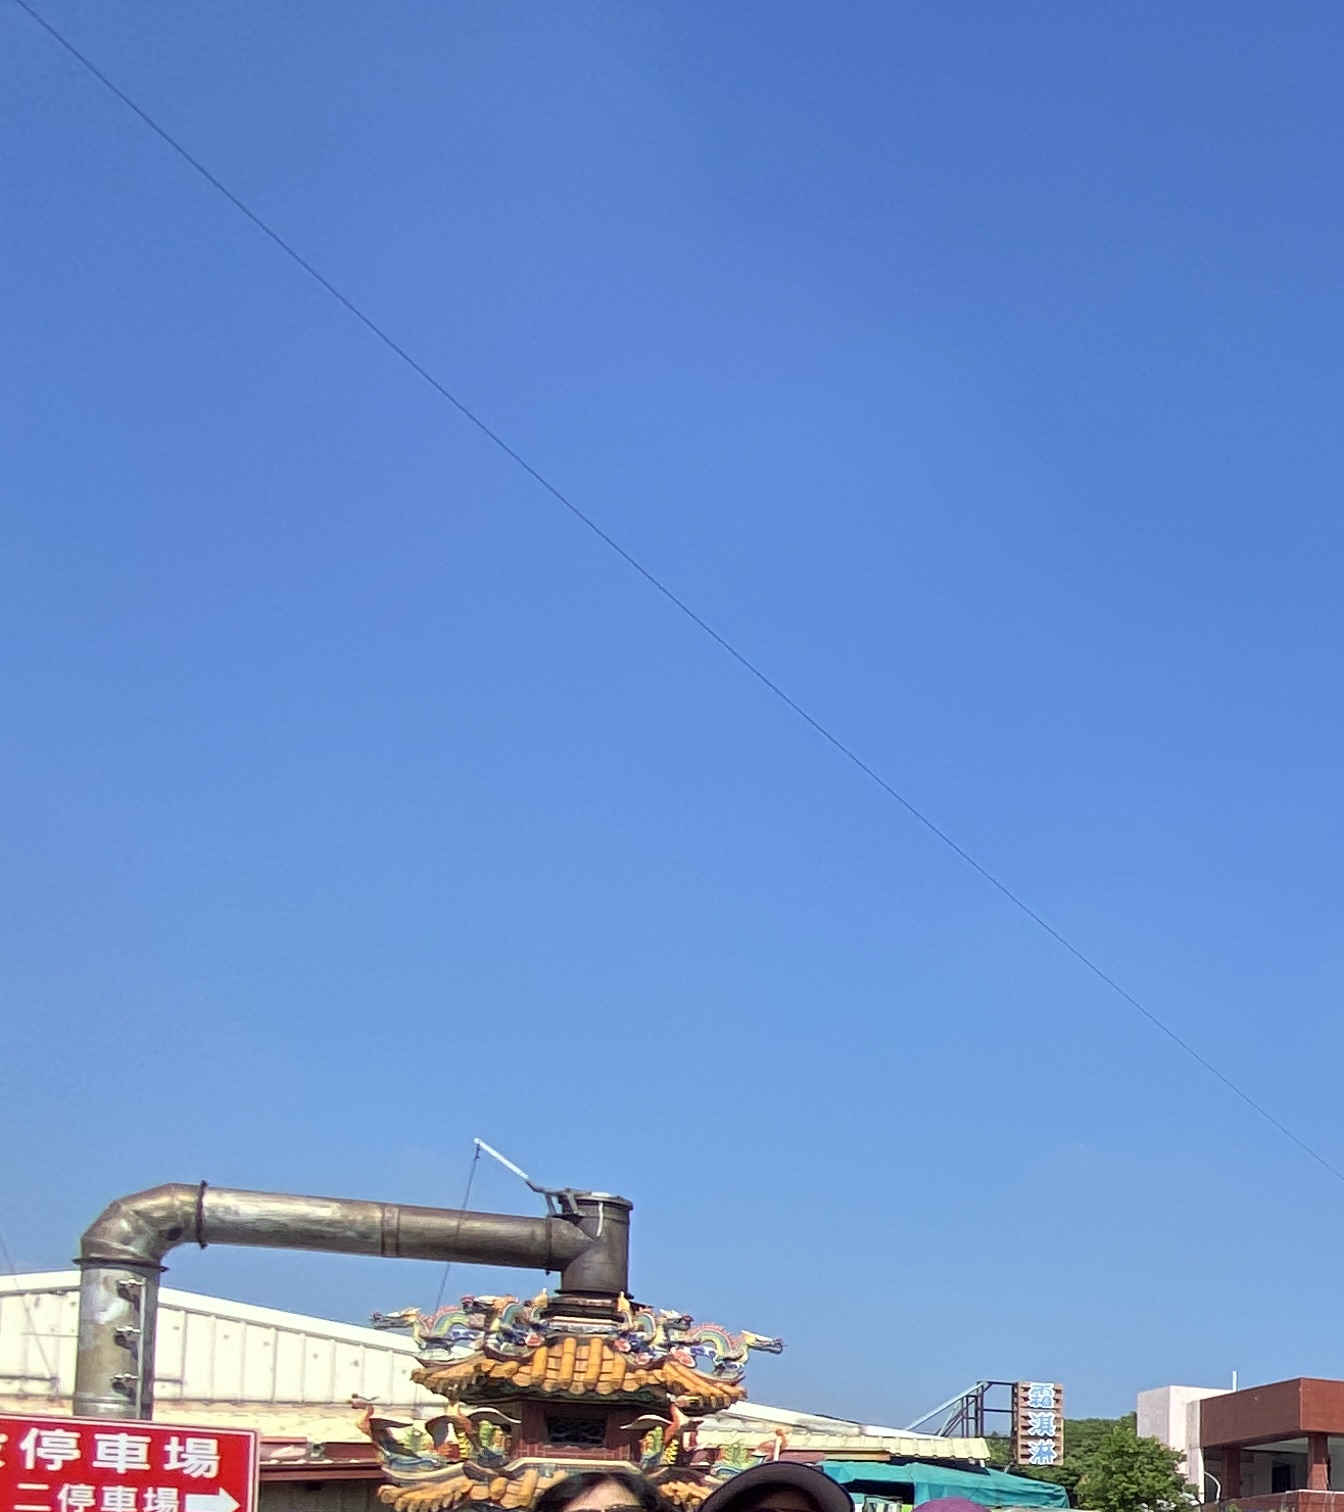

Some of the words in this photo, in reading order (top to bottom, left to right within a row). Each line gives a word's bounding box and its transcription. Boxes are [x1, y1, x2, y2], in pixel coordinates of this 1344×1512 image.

[0, 1426, 221, 1479] 停車場
[1026, 1381, 1058, 1466] 霜淇淋
